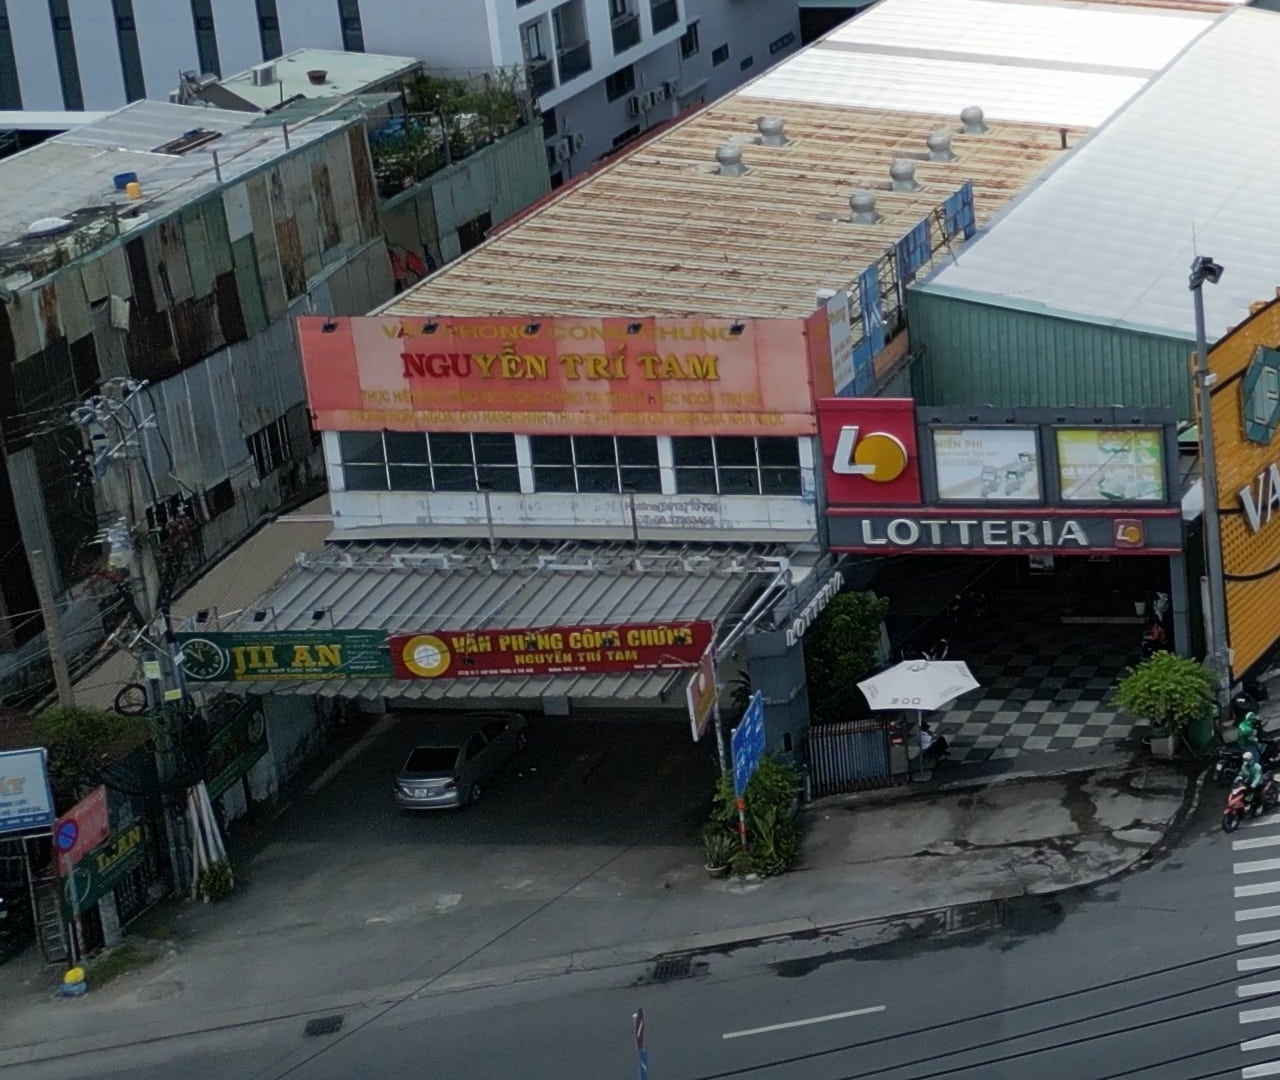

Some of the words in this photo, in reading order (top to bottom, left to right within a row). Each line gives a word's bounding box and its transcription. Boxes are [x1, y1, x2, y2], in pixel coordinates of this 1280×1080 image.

[401, 342, 549, 379] NGUYỄN
[560, 343, 629, 380] TRÍ
[637, 354, 720, 381] TAM
[861, 518, 1089, 546] LOTTERIA
[606, 650, 638, 661] TAM
